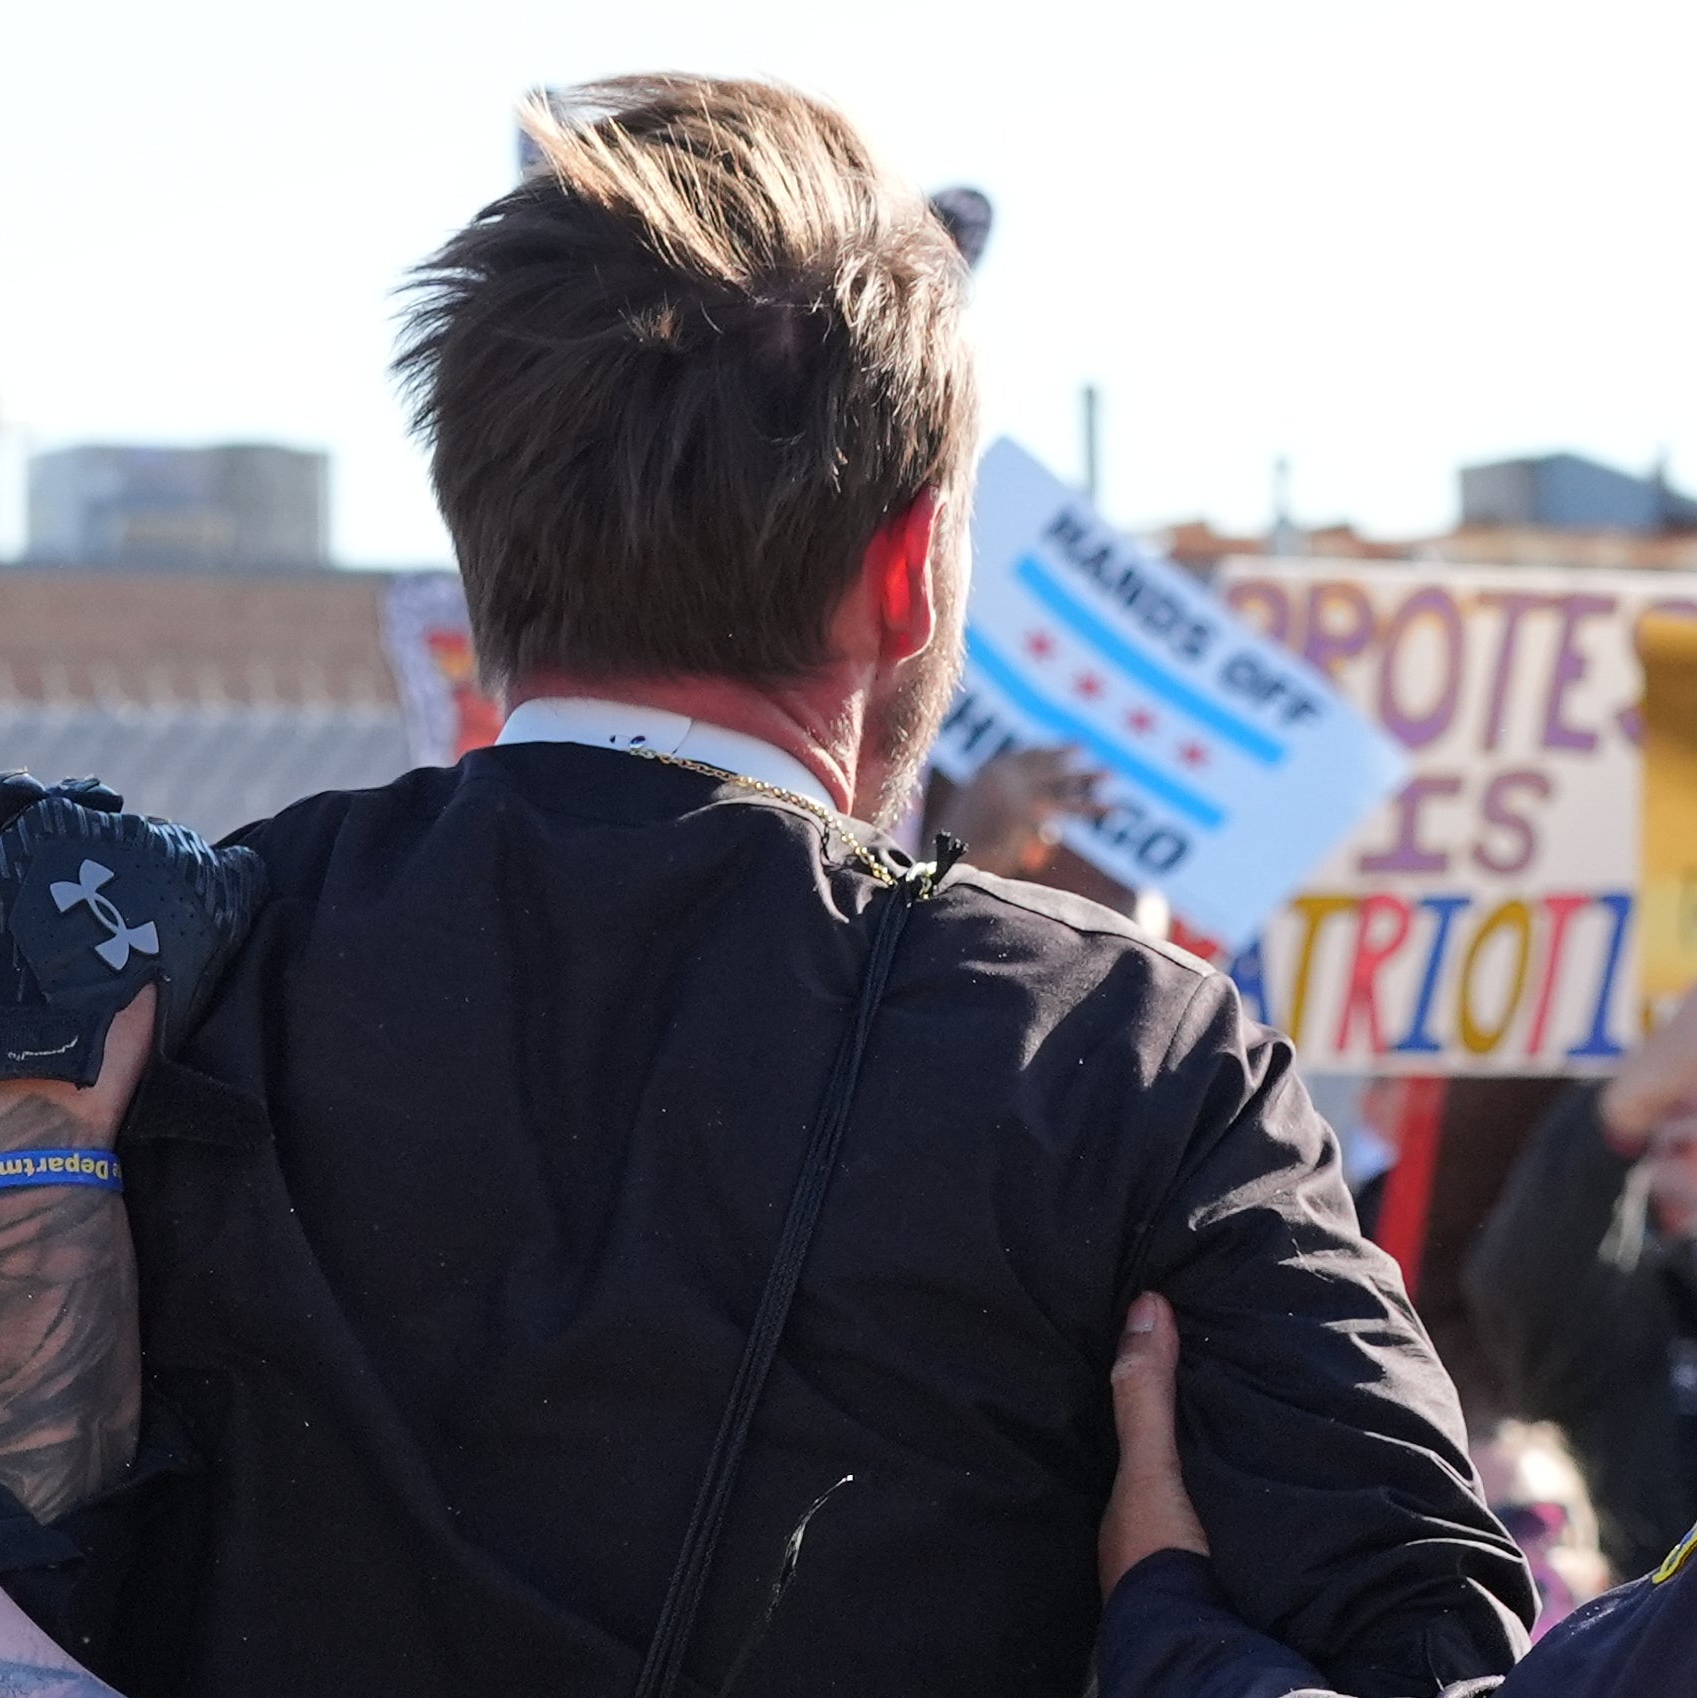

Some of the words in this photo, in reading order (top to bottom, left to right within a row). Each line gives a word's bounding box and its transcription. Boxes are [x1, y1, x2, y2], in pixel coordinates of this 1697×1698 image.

[1043, 507, 1216, 664] HANDS
[938, 695, 1194, 876] HIGO
[1357, 772, 1556, 877] IS
